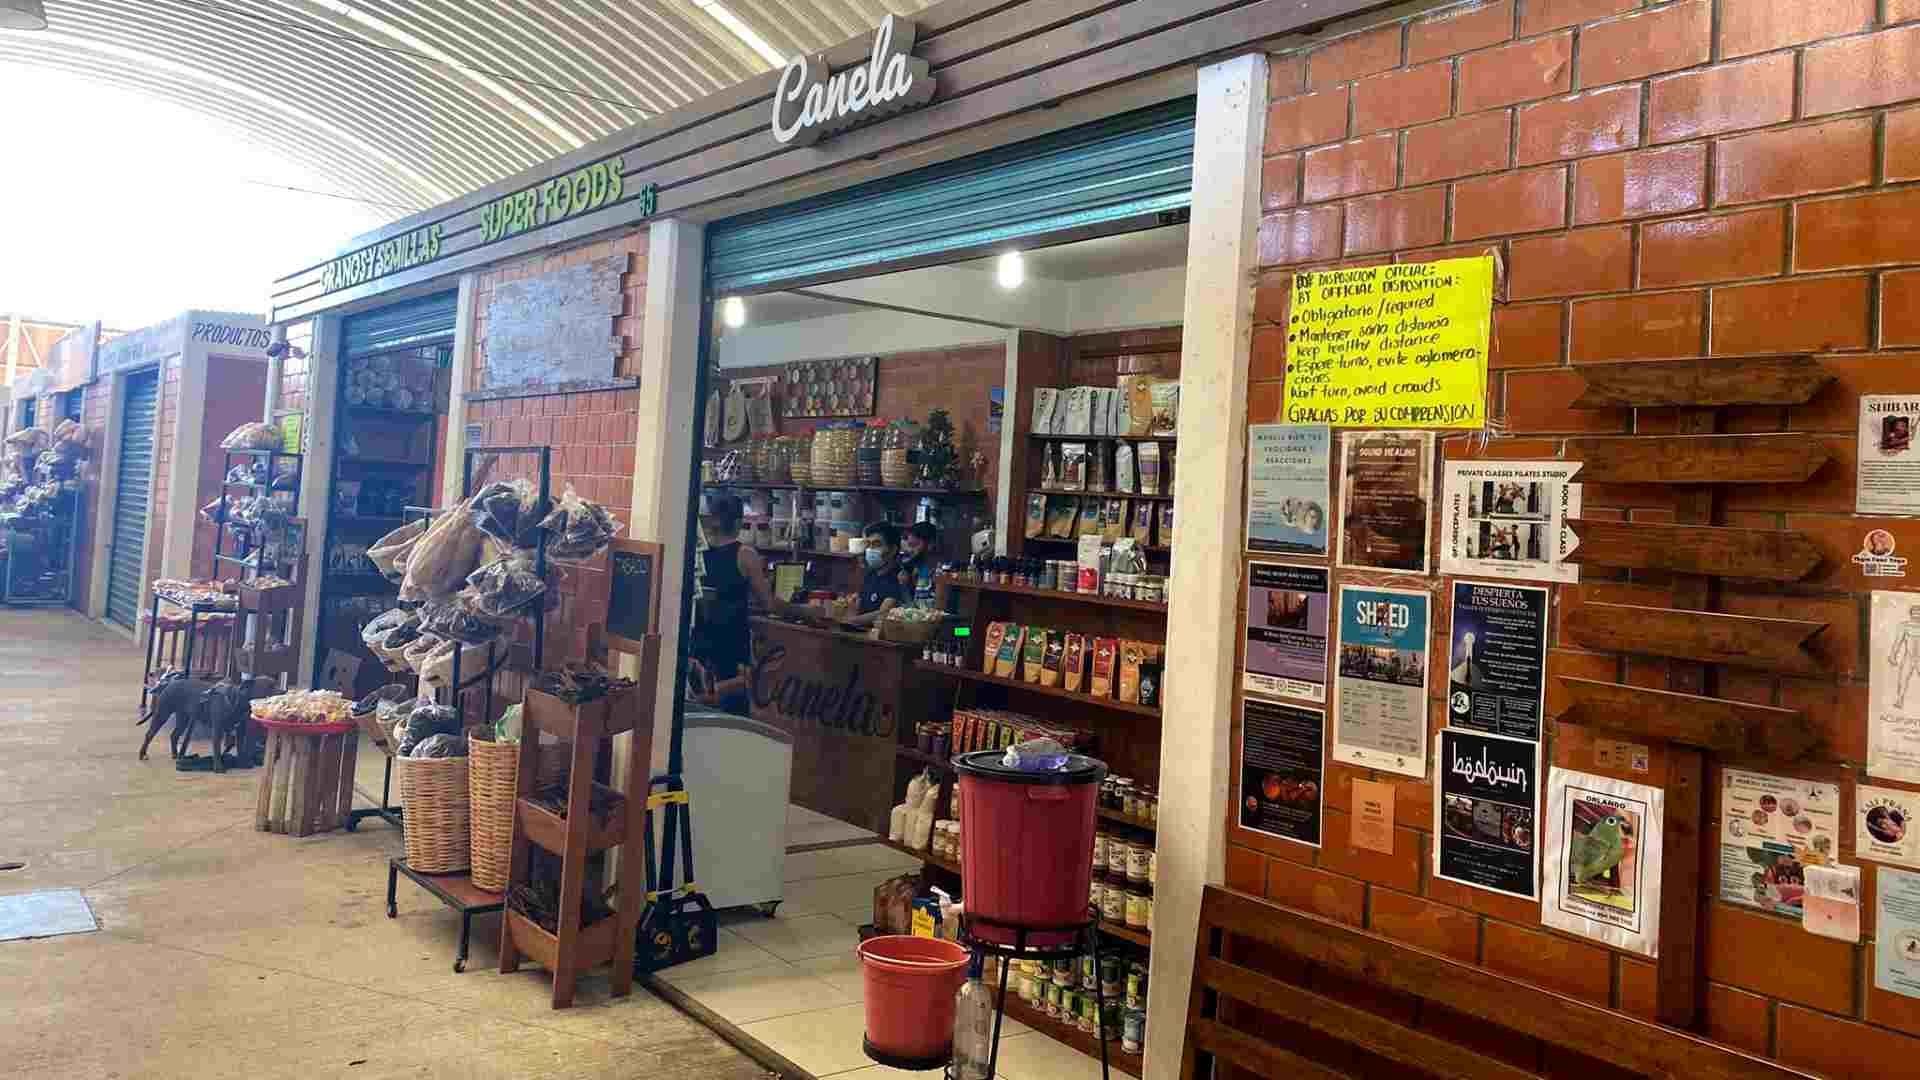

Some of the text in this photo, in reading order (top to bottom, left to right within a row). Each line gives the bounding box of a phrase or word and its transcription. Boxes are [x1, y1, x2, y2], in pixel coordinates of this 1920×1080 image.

[772, 14, 912, 143] Canela
[480, 155, 625, 241] SUPER FOODS
[321, 252, 366, 294] GRANOS
[375, 223, 442, 276] SEMILLAS
[1321, 284, 1373, 300] OFFICIAL
[192, 322, 272, 349] PRODUCTOS
[1300, 326, 1352, 343] Mantener
[1379, 332, 1441, 351] distance
[1377, 350, 1408, 367] evite
[1294, 374, 1331, 384] ciones
[1393, 376, 1441, 394] crowds
[1288, 403, 1338, 422] GRACIAS
[1344, 406, 1367, 423] POR
[1515, 470, 1541, 478] PILATES
